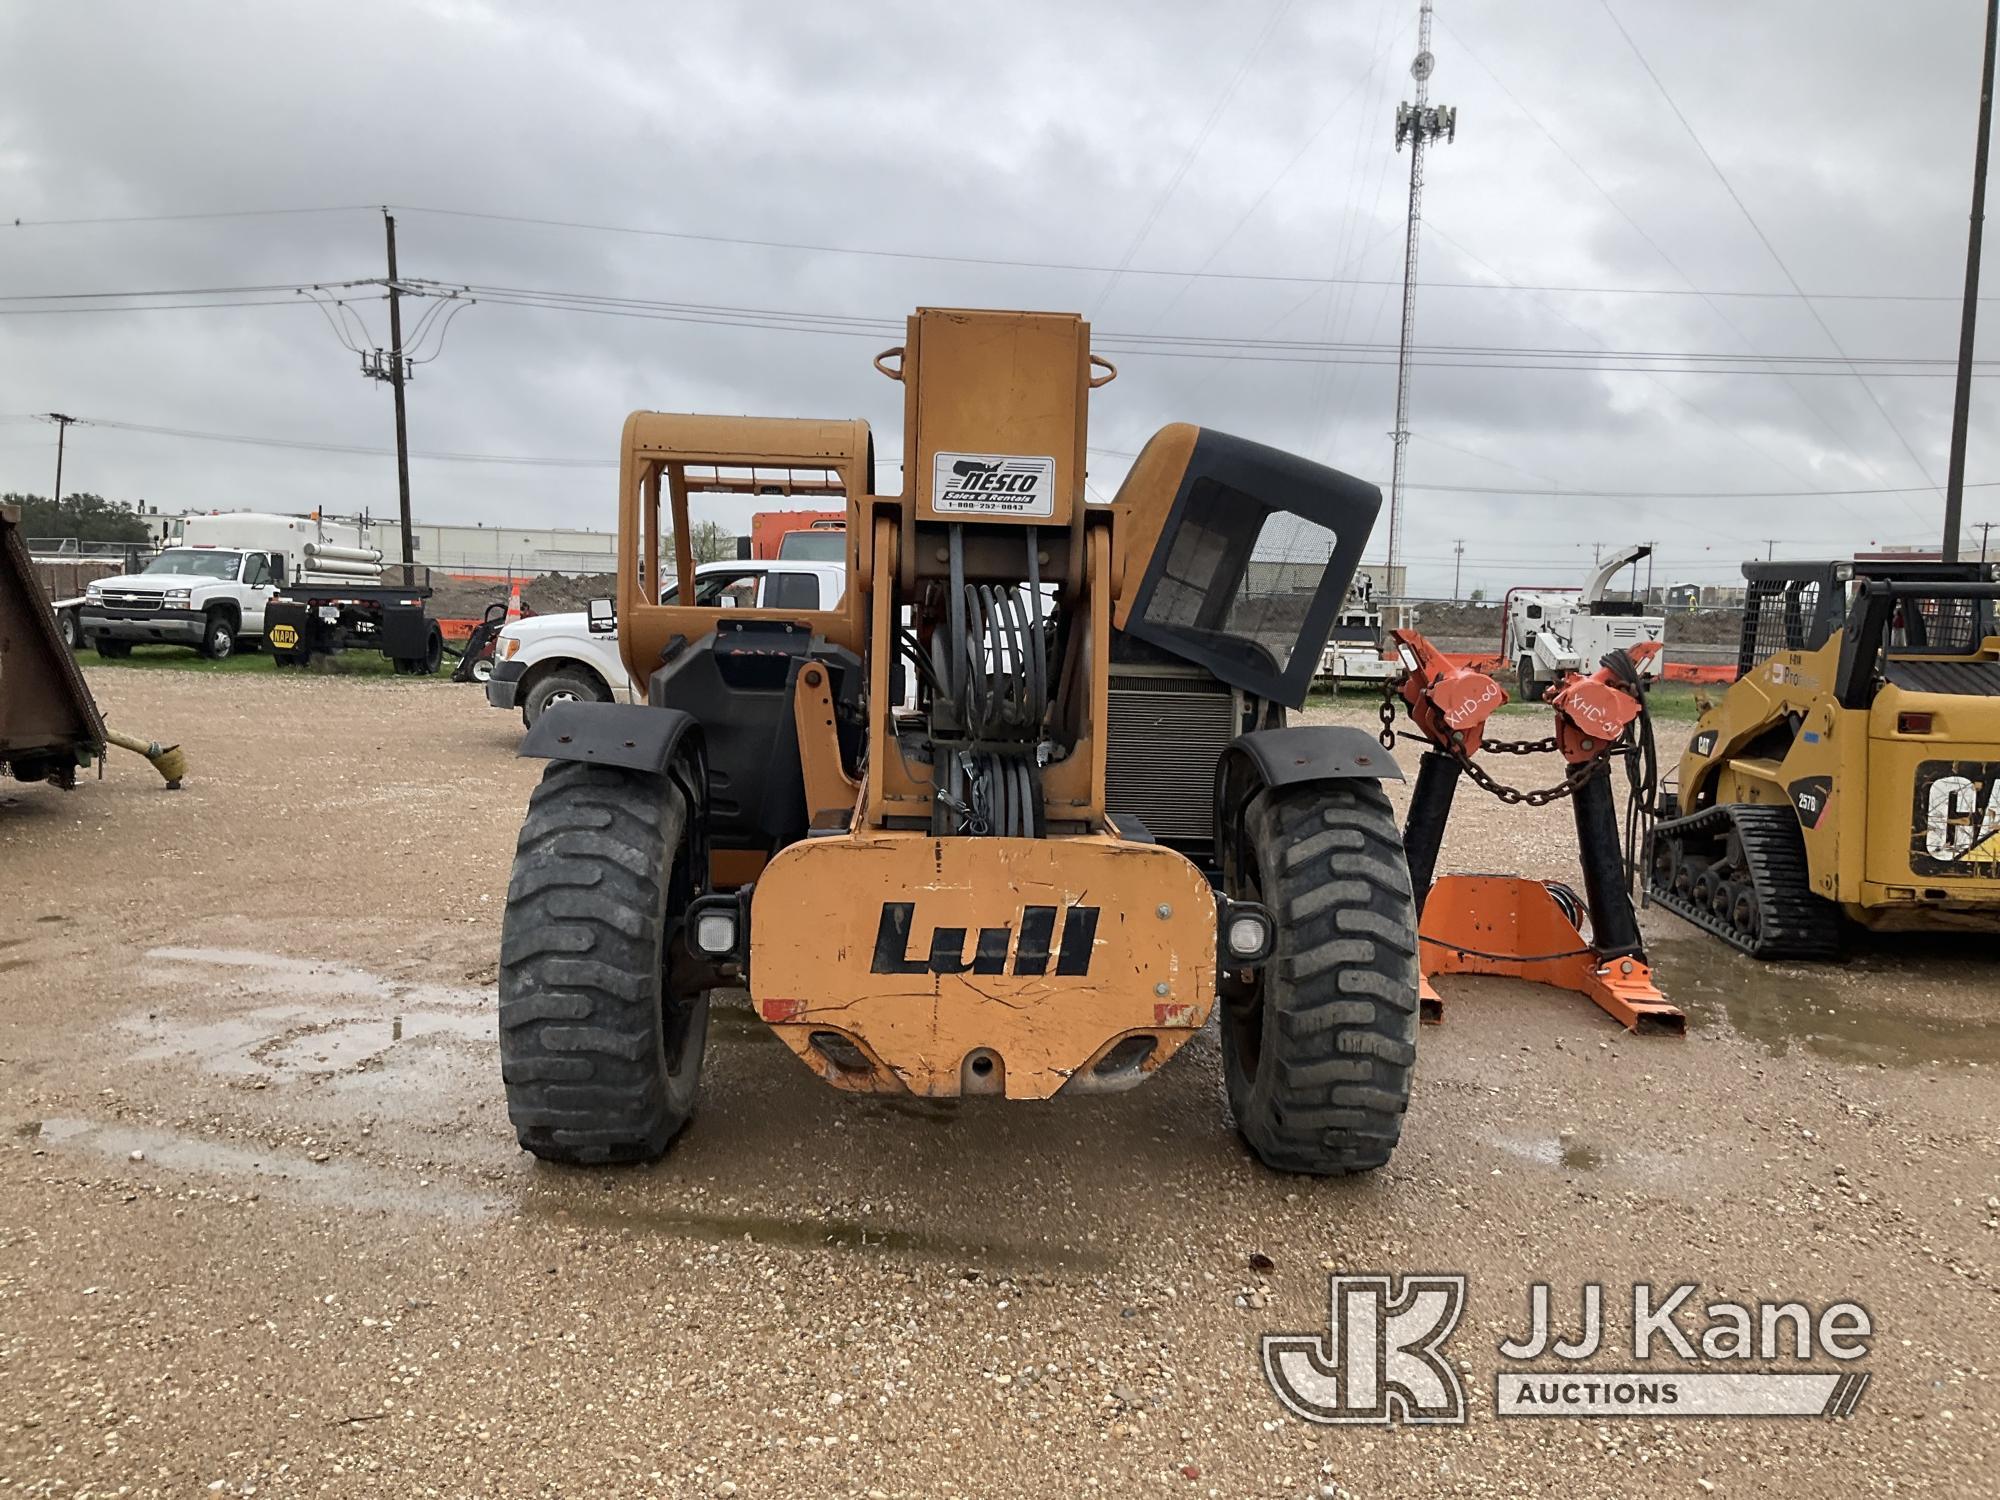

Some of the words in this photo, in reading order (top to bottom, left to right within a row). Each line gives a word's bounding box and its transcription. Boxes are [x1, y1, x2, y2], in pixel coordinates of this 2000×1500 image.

[945, 492, 975, 500] Sales
[989, 495, 1031, 503] Rentals
[274, 630, 295, 643] NAPA
[1698, 736, 1710, 755] CAT
[870, 901, 1100, 976] Lull
